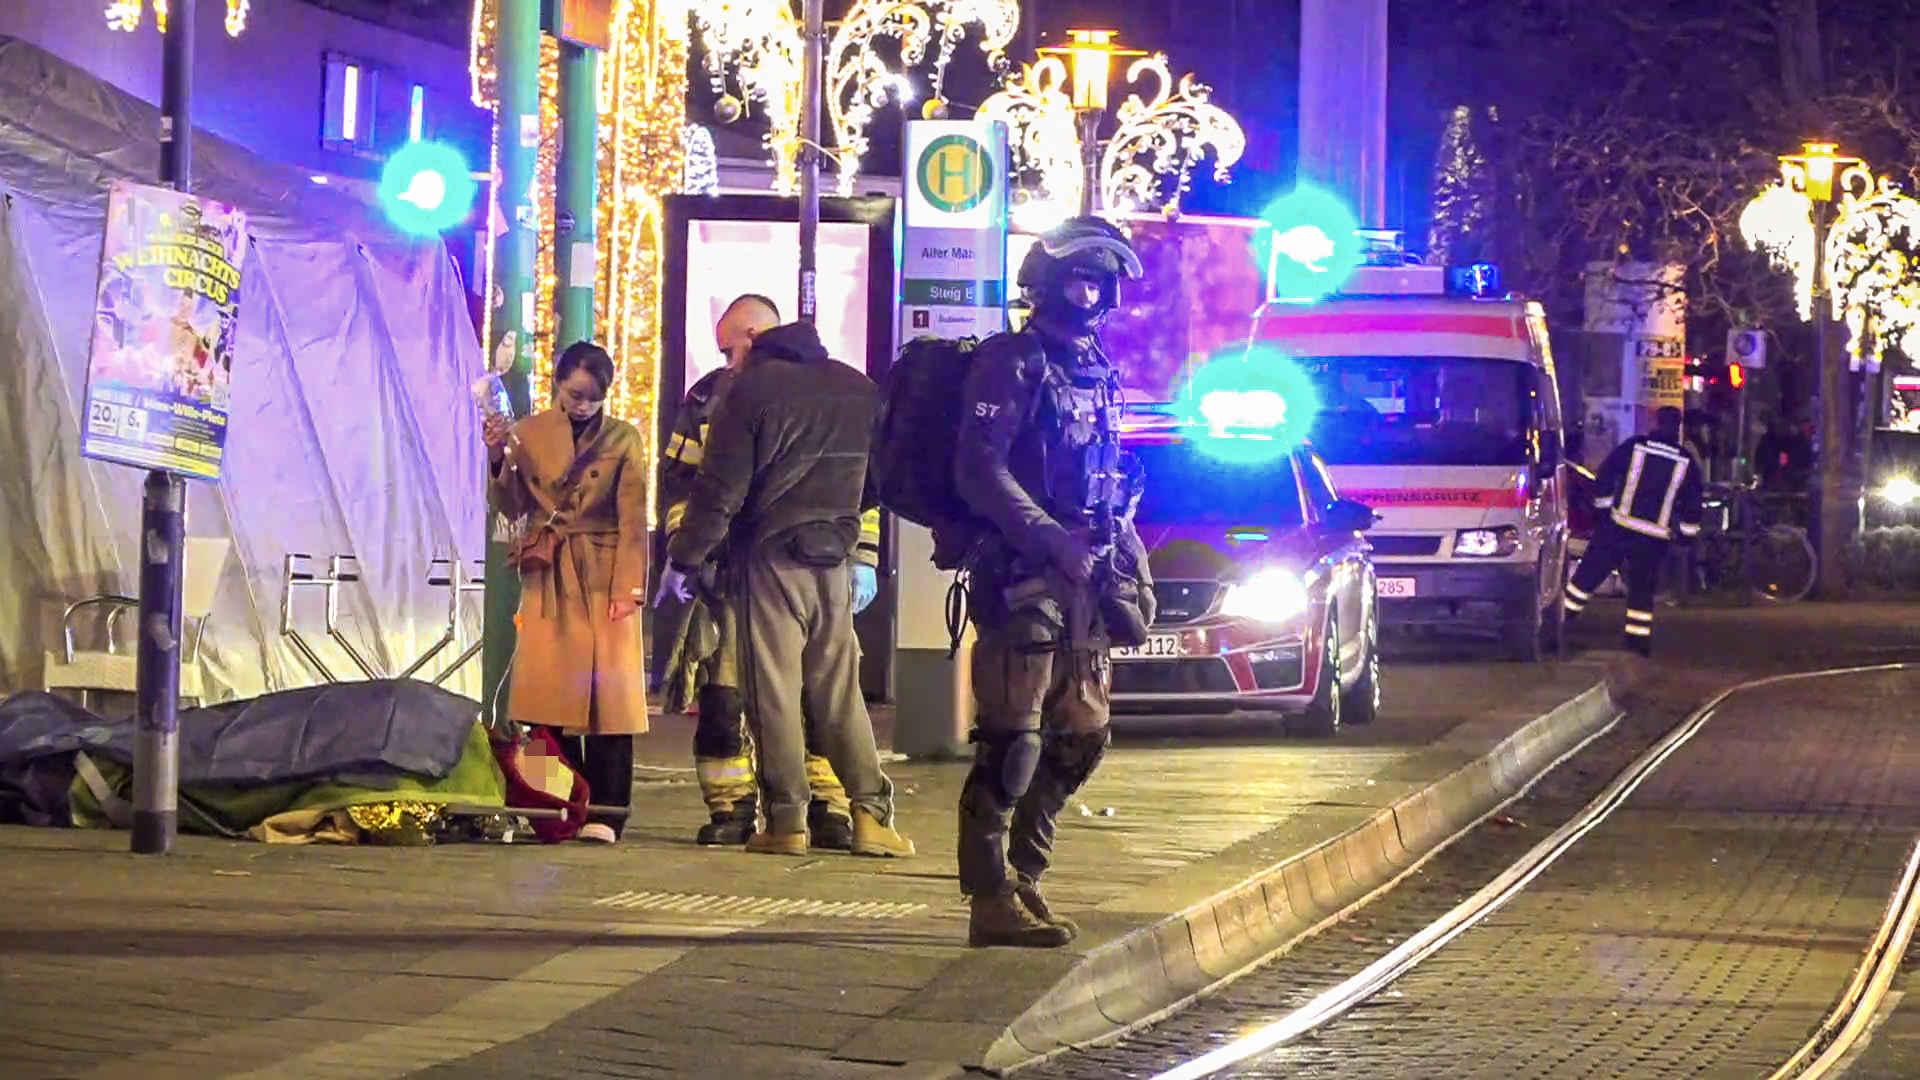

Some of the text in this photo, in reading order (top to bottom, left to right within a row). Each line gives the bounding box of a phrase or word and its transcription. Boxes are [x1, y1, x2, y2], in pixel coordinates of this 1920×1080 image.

[938, 151, 971, 195] H
[112, 244, 241, 289] WEIHNACHTS
[164, 267, 229, 304] CIRCUS
[1378, 579, 1406, 594] 285
[1144, 637, 1177, 656] 112
